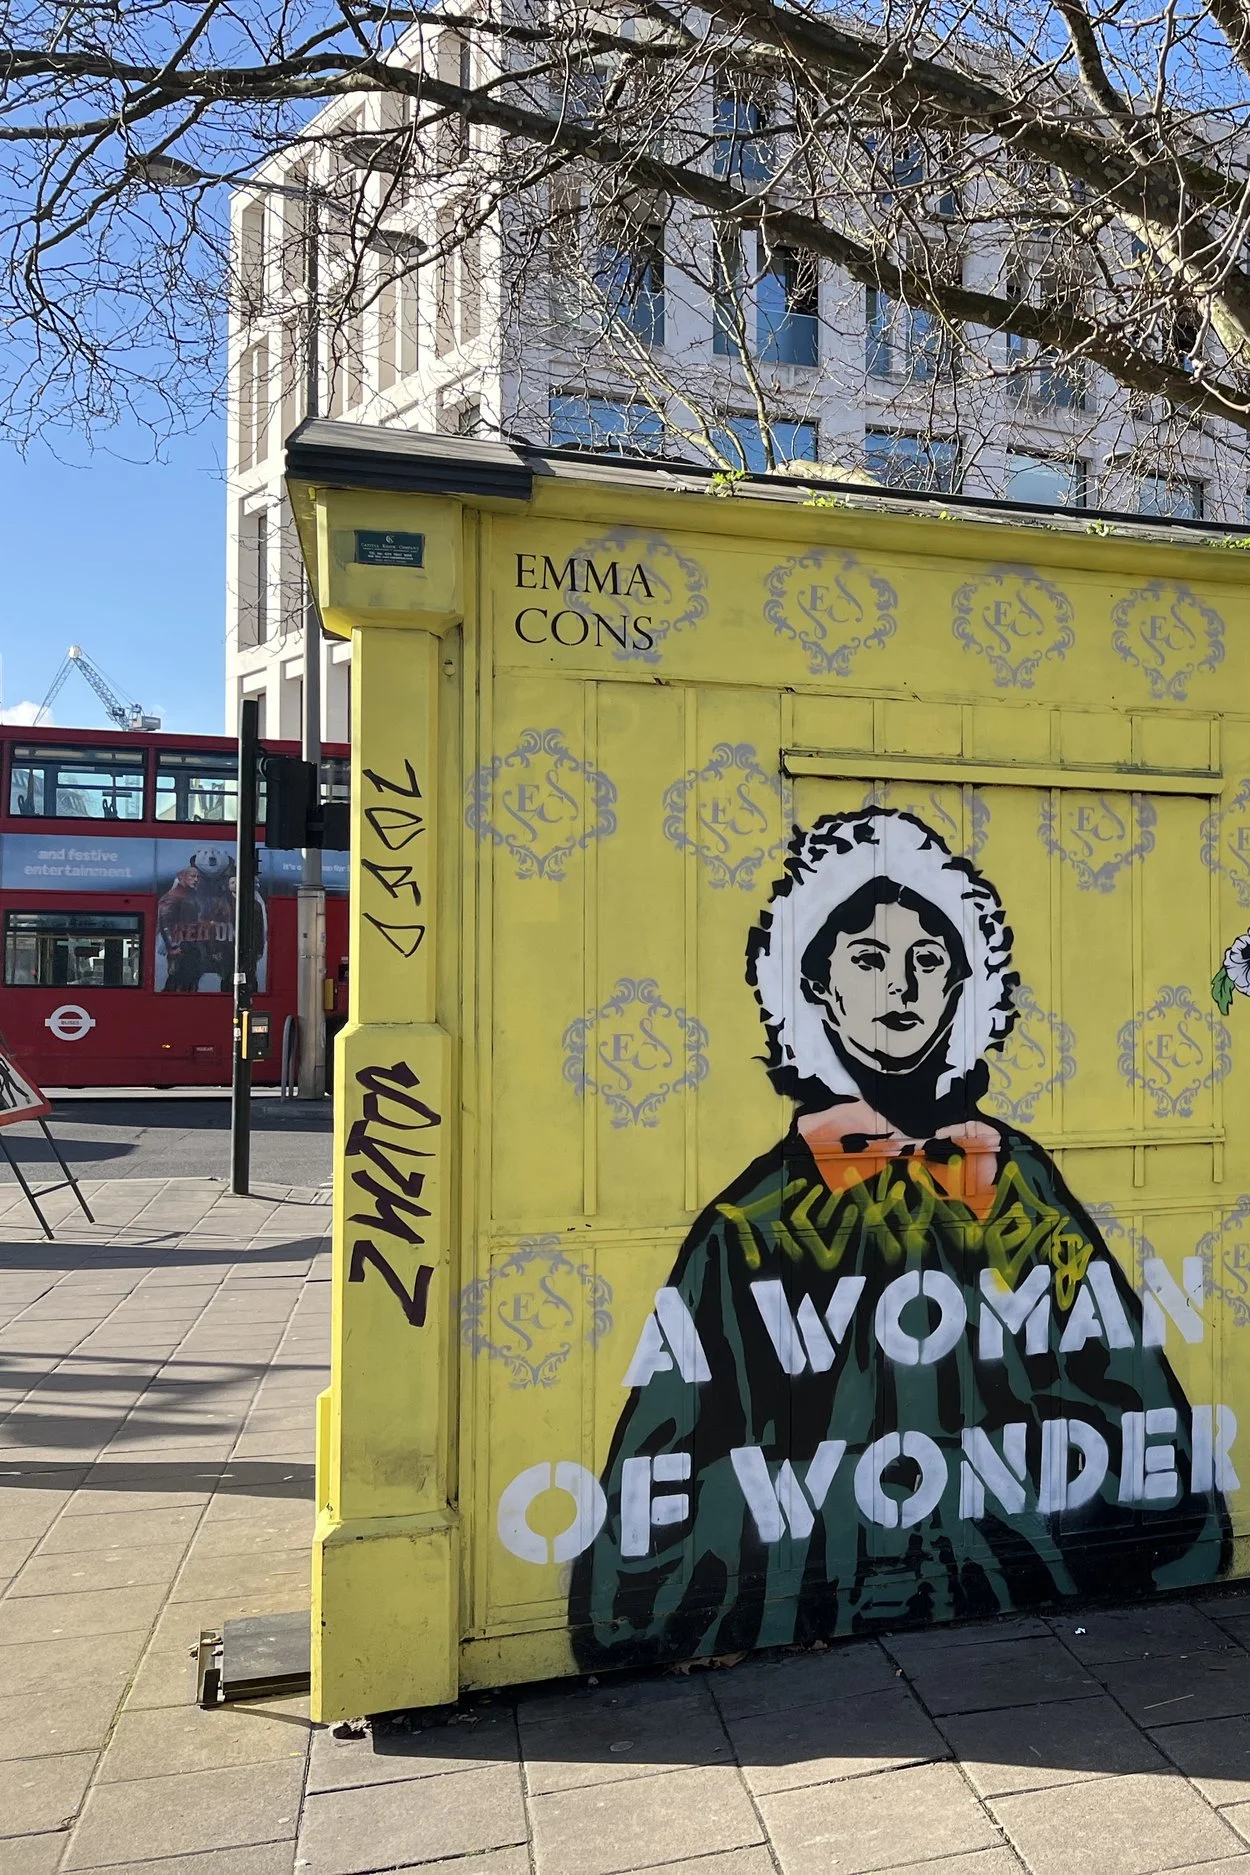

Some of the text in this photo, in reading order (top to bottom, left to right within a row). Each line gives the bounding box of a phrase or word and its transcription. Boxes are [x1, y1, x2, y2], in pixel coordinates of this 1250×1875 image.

[514, 552, 656, 598] EMMA
[514, 608, 655, 651] CONS
[23, 864, 132, 878] entertainment
[37, 848, 118, 861] and festive
[621, 1256, 1204, 1387] A WOMAN
[499, 1405, 1240, 1565] OF WONDER
